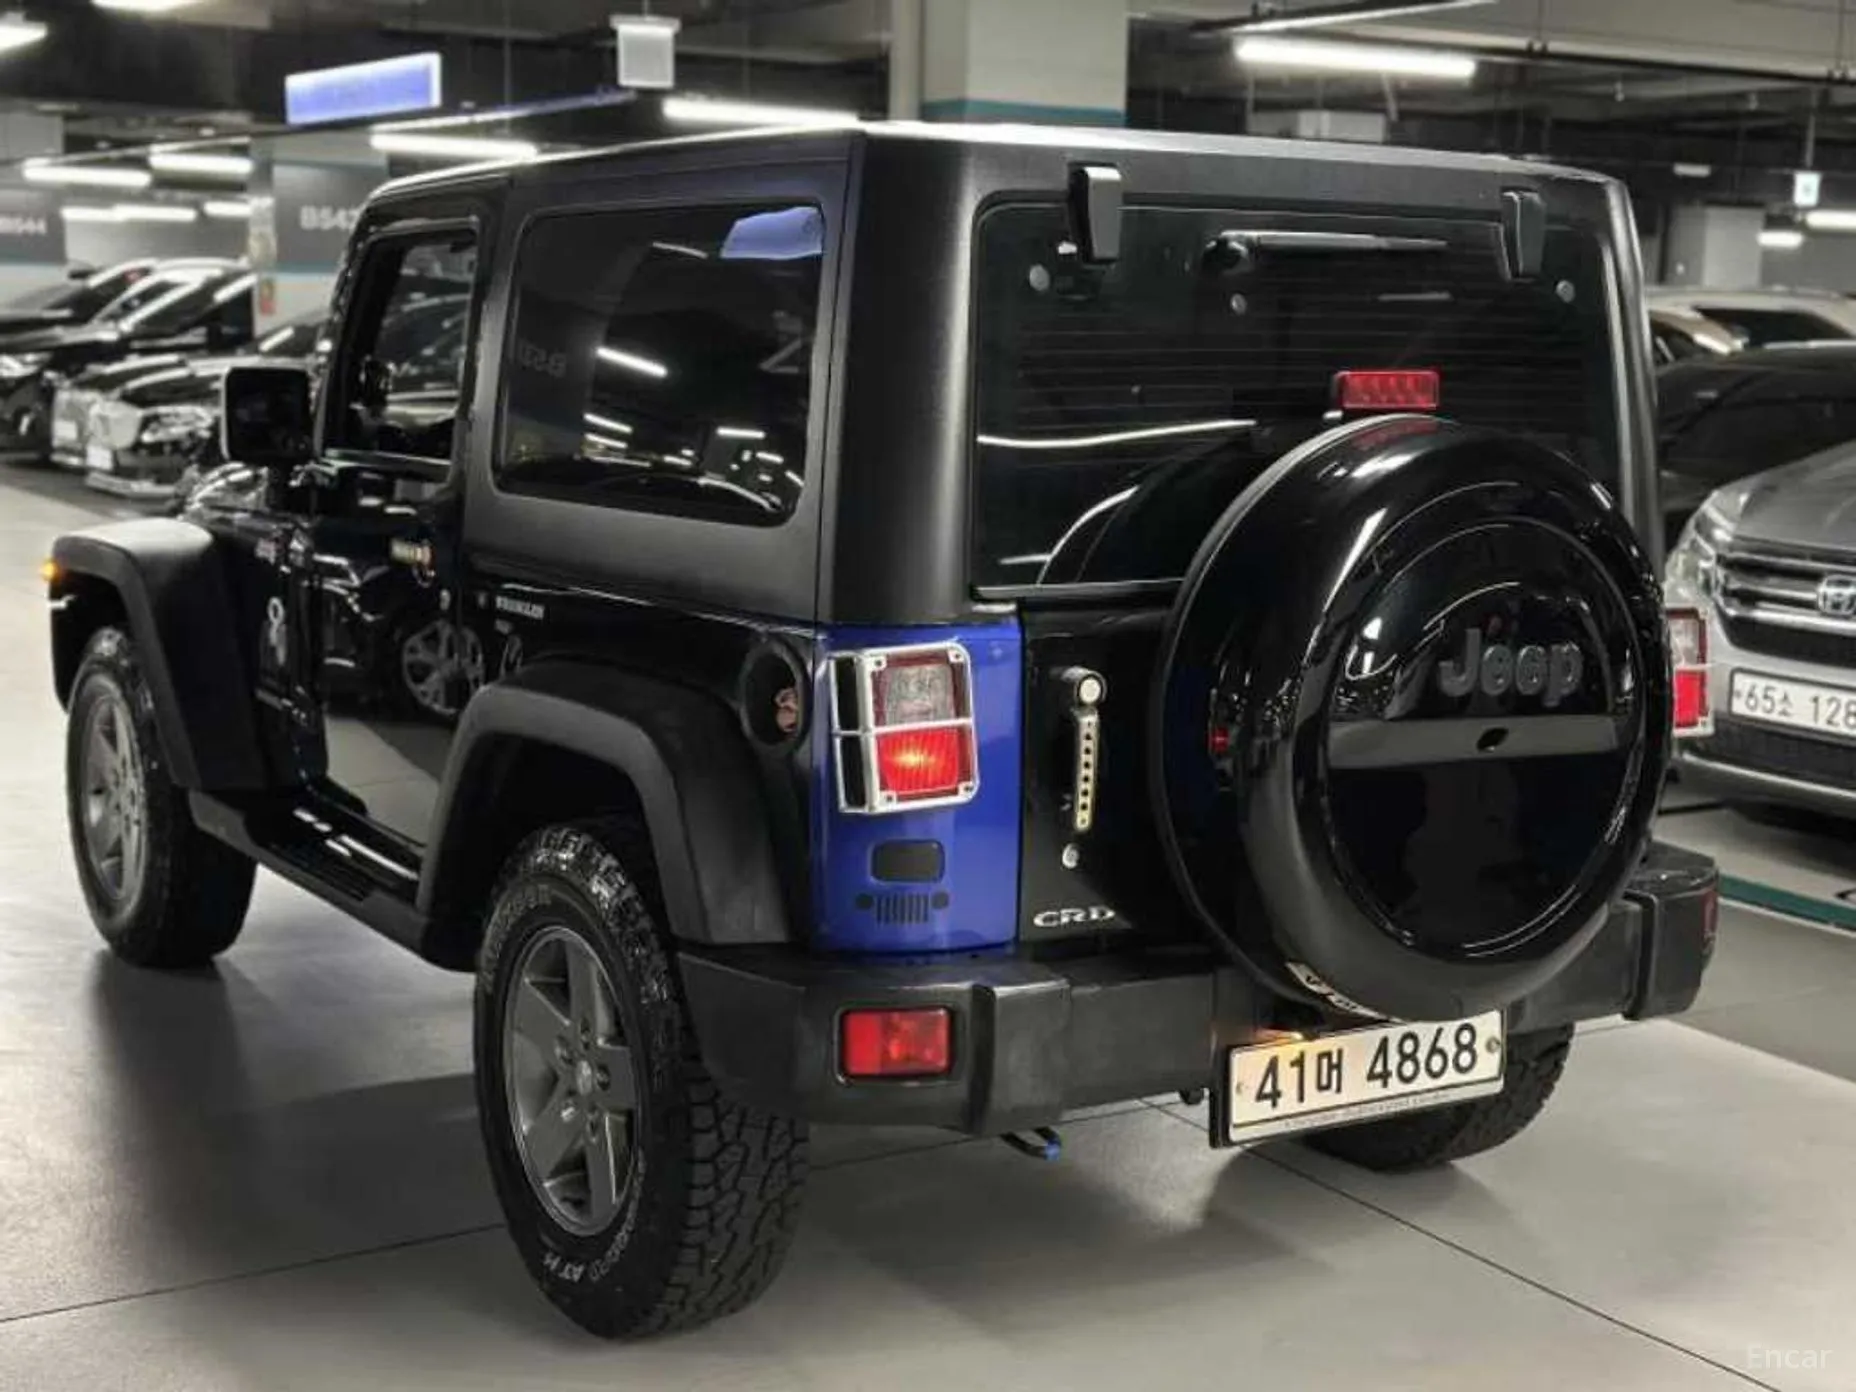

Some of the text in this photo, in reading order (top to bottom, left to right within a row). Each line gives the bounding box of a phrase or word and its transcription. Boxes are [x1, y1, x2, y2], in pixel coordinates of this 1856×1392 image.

[1438, 628, 1583, 707] Jeep
[1033, 905, 1116, 927] CRD
[1255, 1023, 1477, 1108] 41머 4868
